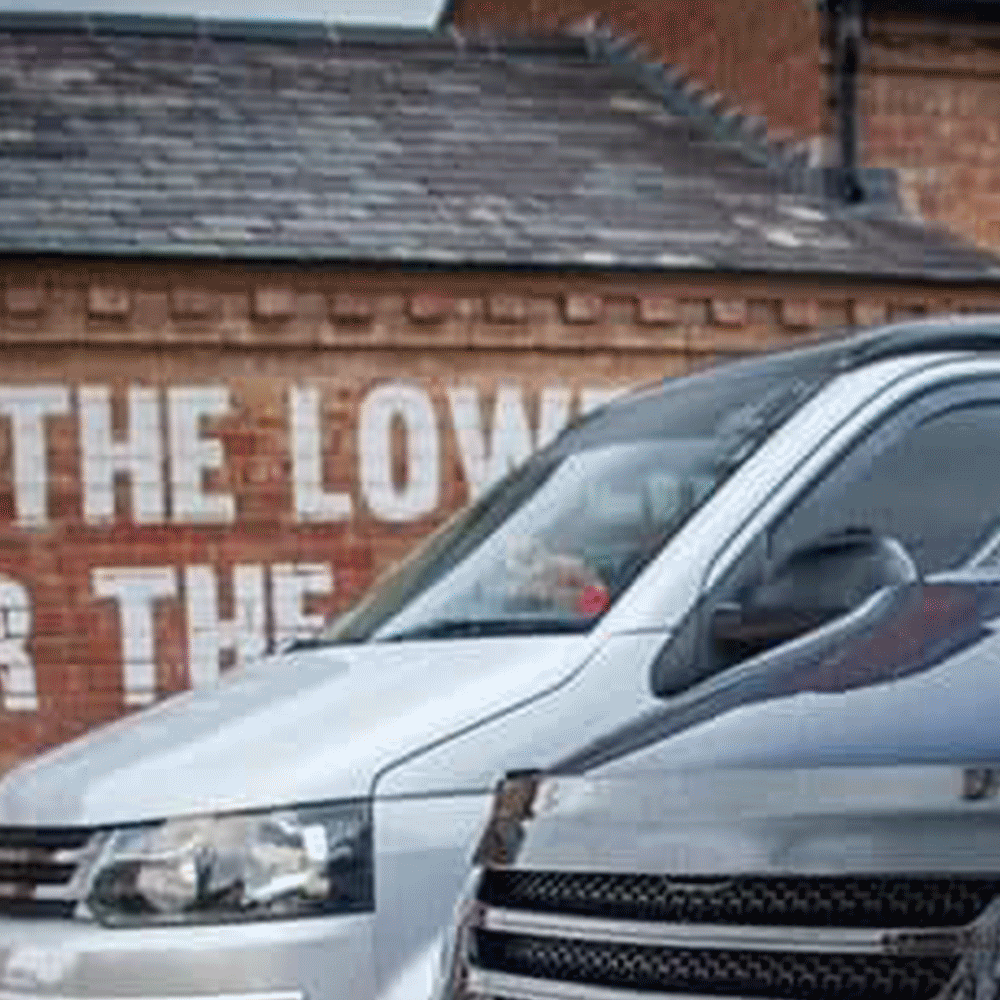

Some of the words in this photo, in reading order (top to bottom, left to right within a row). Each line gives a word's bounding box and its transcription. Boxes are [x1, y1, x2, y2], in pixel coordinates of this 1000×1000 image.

[0, 385, 235, 528] THE
[290, 384, 632, 523] LOW
[92, 563, 334, 704] THE
